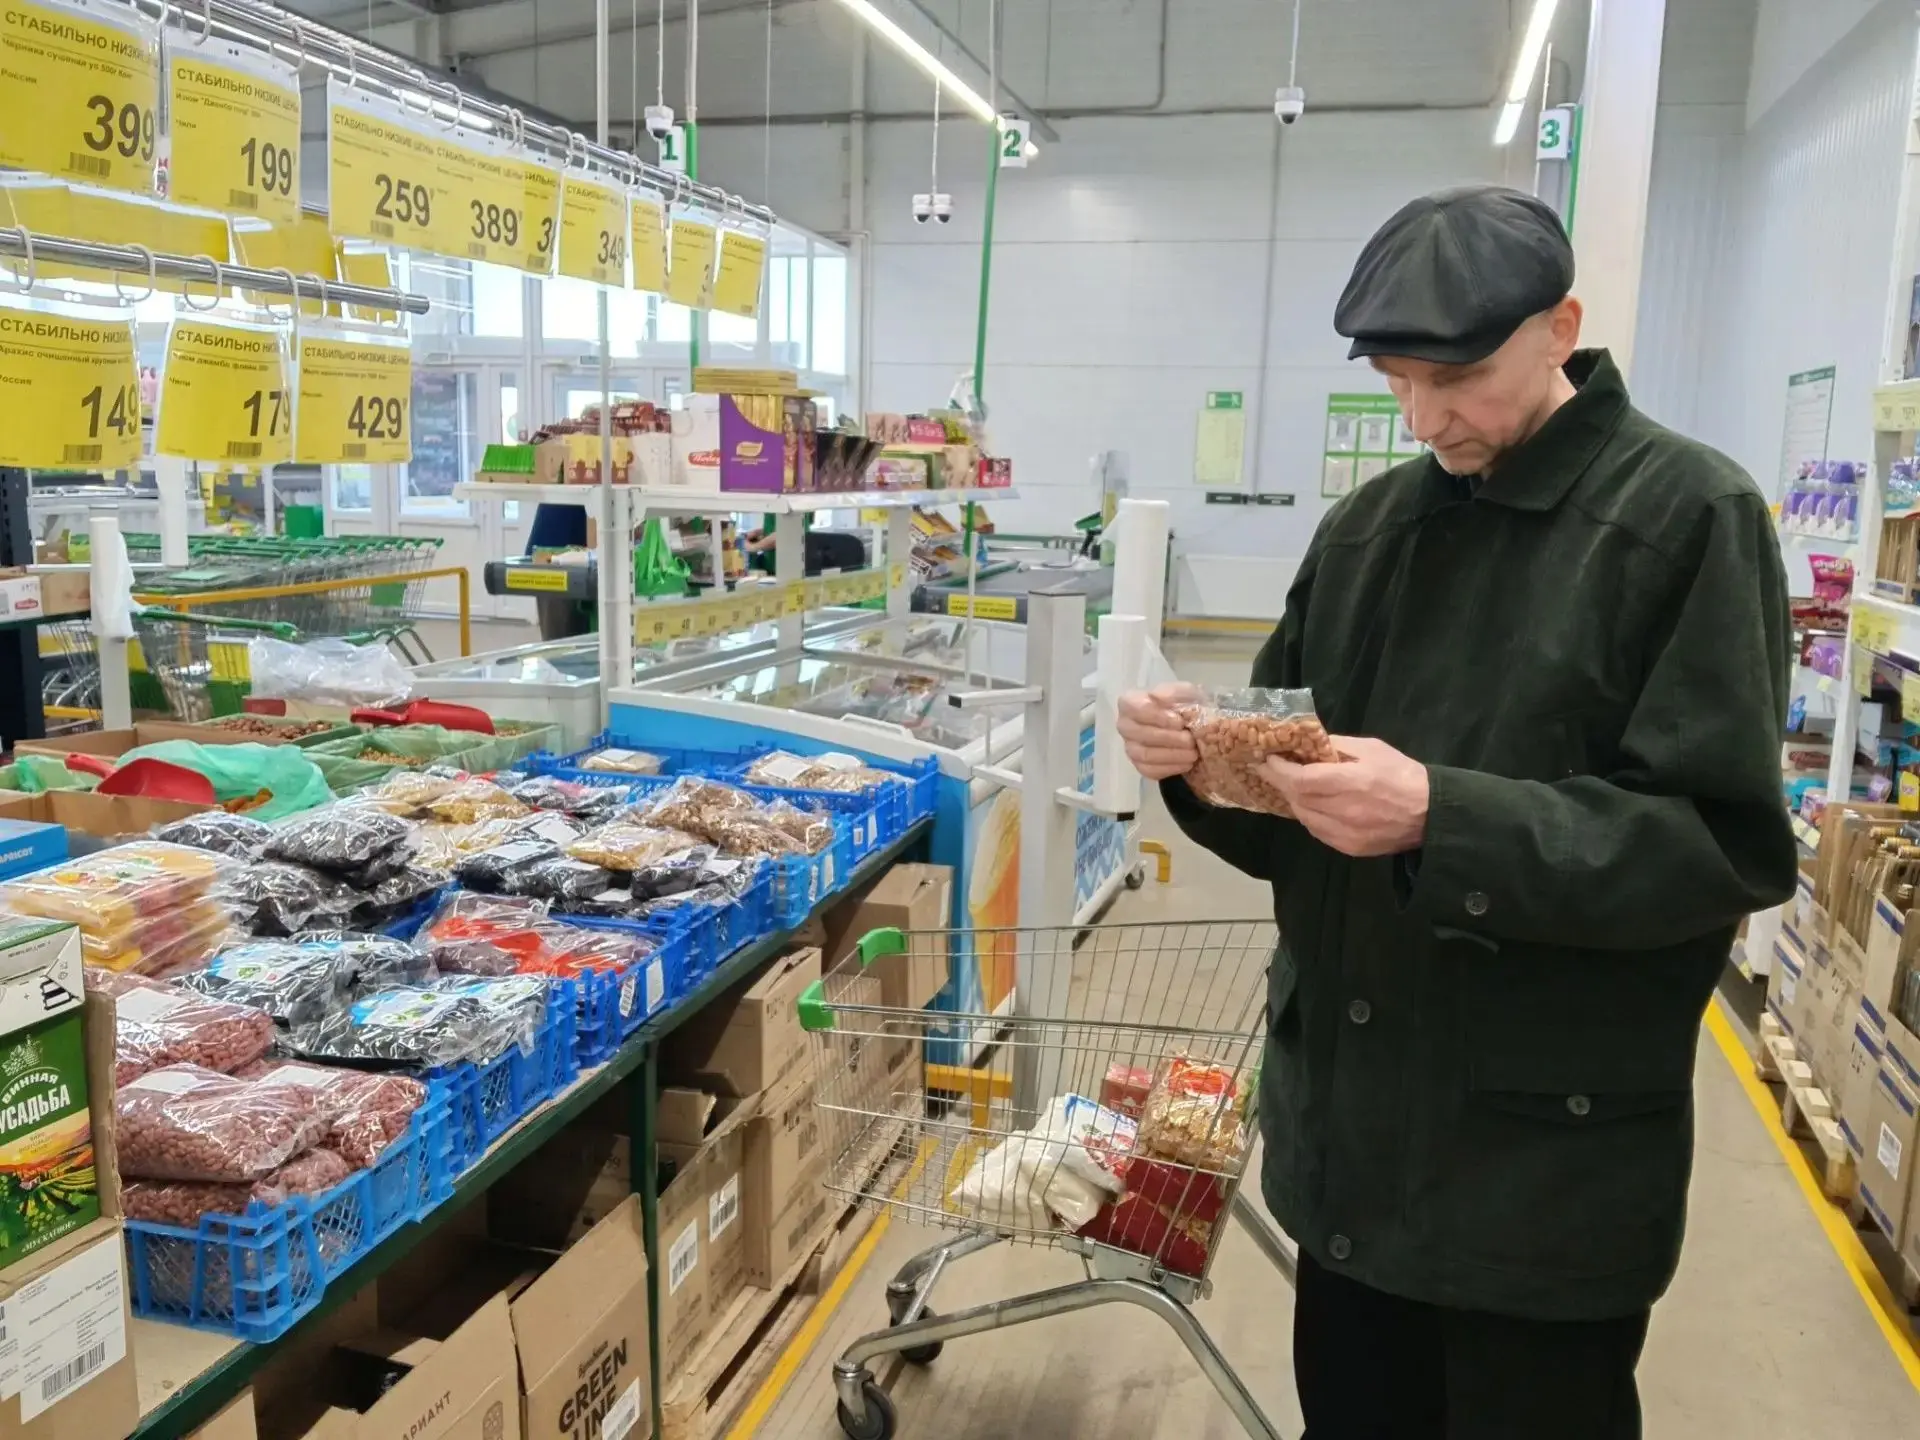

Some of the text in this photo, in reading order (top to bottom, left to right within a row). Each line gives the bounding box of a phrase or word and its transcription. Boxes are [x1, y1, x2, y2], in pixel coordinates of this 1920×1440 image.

[5, 10, 146, 62] СТАБИЛЬНО НИЗК
[177, 67, 253, 96] СТАБИЛЬНО
[83, 95, 155, 162] 399
[334, 113, 384, 138] СТАБИЛЬНО
[384, 130, 413, 148] НИЗКИЕ
[661, 135, 678, 161] 1
[1003, 128, 1022, 158] 2
[1540, 119, 1560, 149] 3
[240, 137, 292, 197] 199
[375, 173, 430, 228] 259
[470, 199, 519, 248] 389
[0, 318, 101, 344] СТАБИЛЬНО
[176, 329, 261, 353] СТАБИЛЬНО
[304, 347, 356, 361] СТАБИЛЬНО
[357, 351, 386, 364] НИЗКИЕ
[81, 383, 138, 438] 149
[348, 395, 403, 440] 429
[0, 1083, 72, 1135] УСАДЬБА
[2, 1072, 60, 1105] ВИННАЯ
[558, 1337, 628, 1434] GREEN
[572, 1384, 617, 1440] INE
